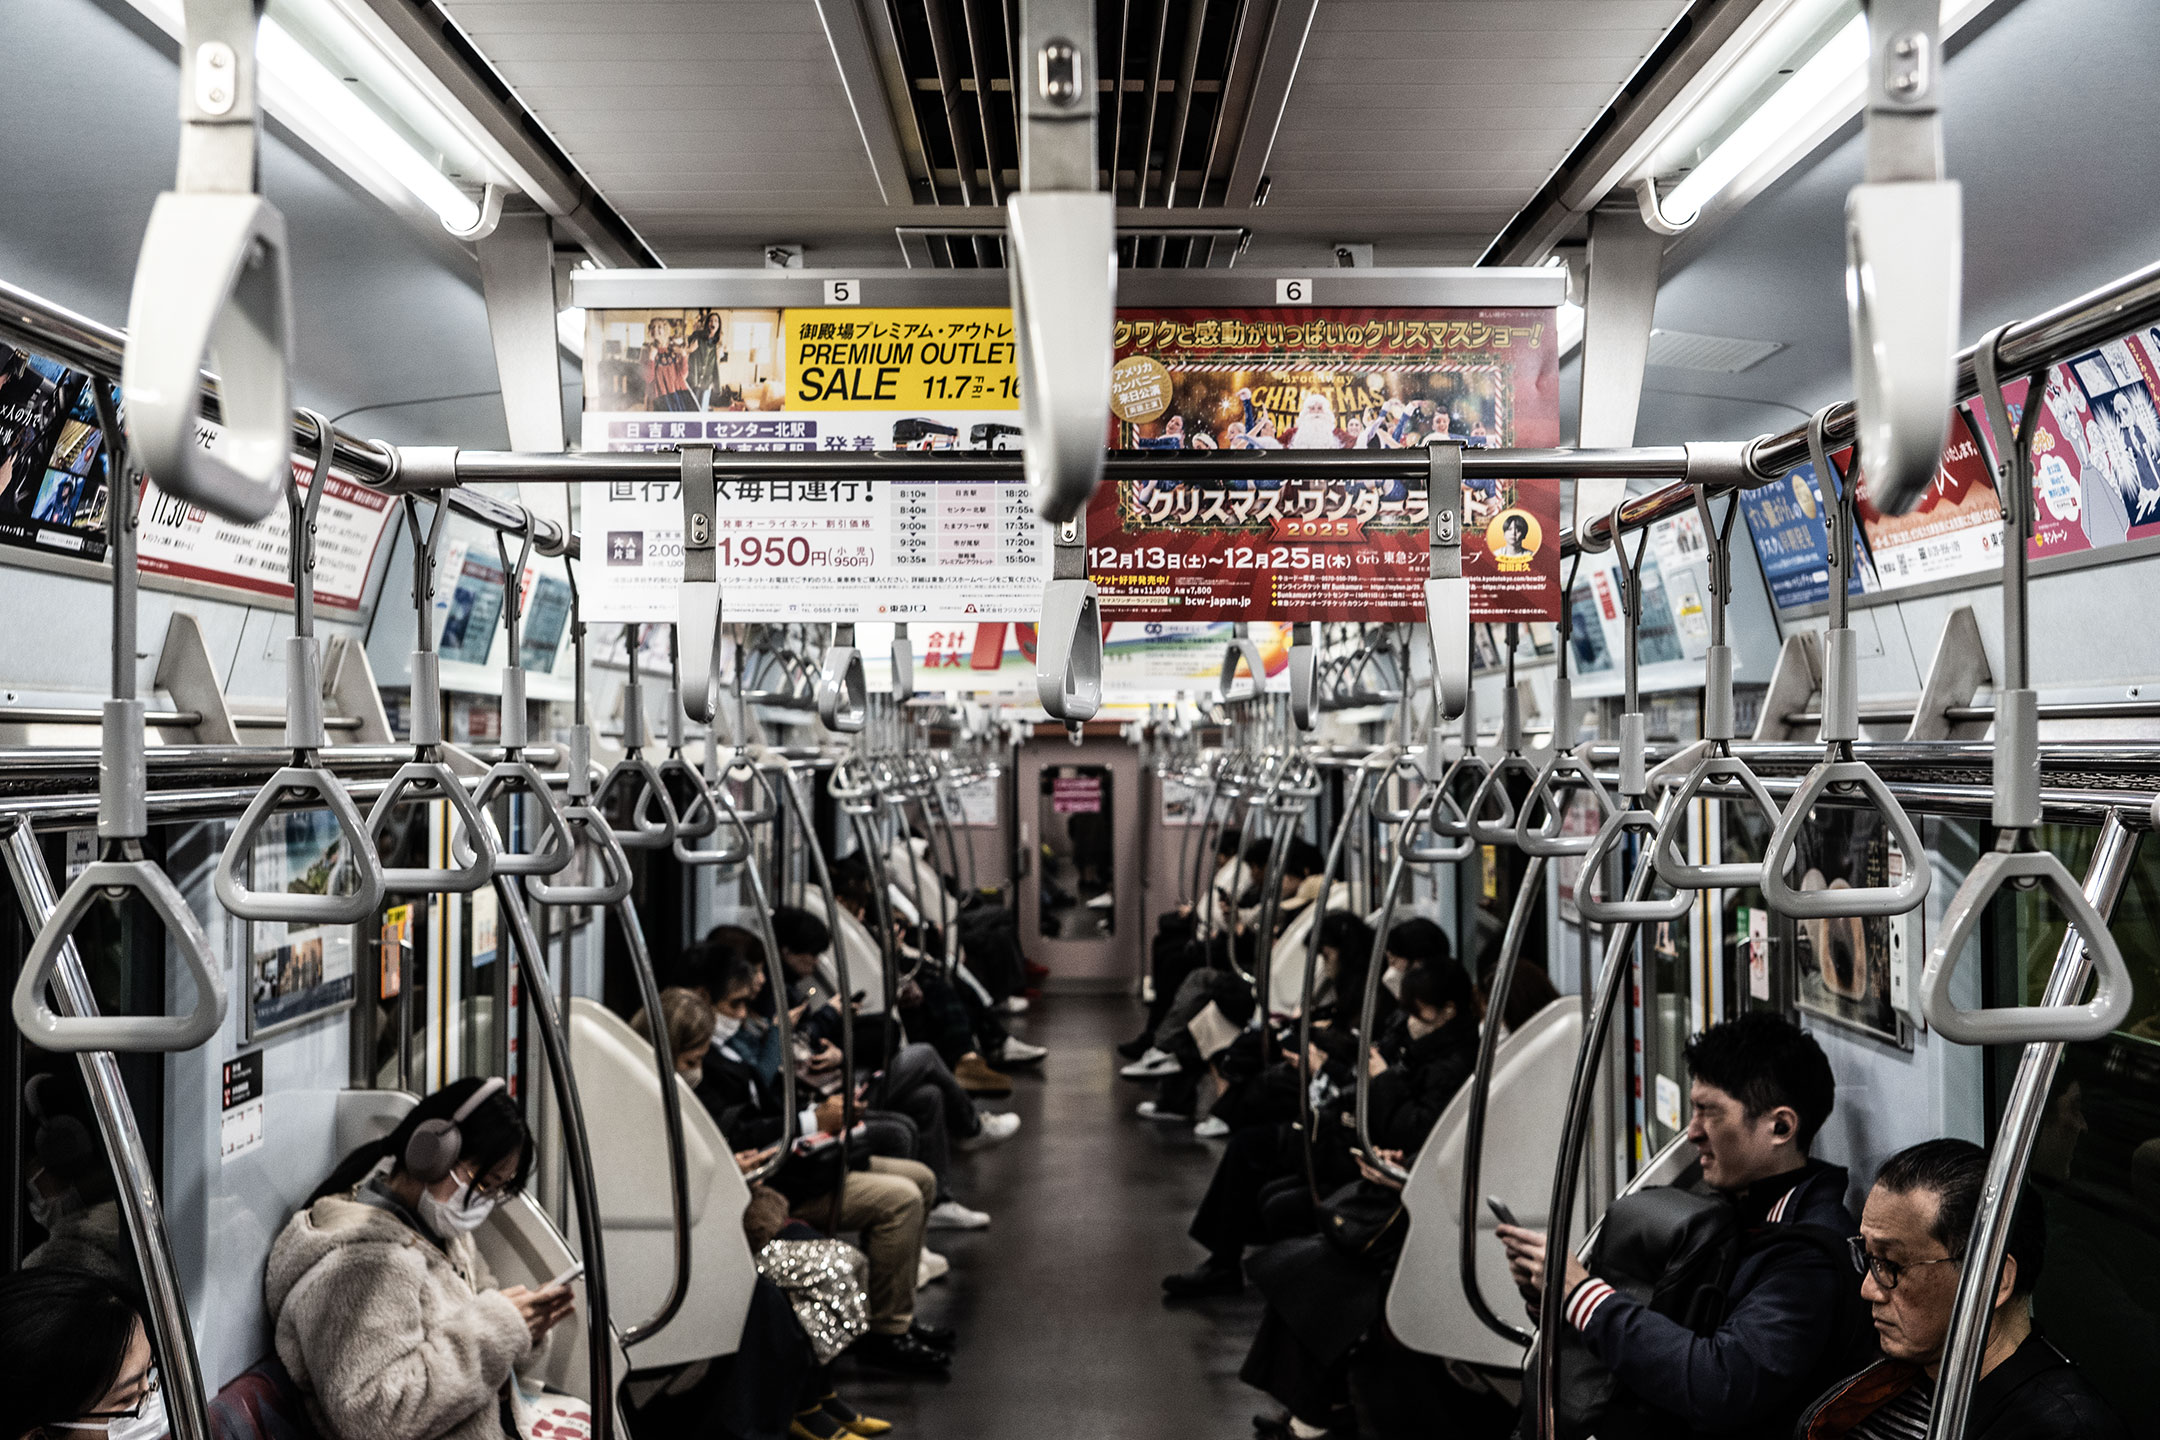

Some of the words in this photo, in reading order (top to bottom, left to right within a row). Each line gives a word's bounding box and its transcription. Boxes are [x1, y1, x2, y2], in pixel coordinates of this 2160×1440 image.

[834, 282, 848, 300] 5
[1287, 282, 1301, 300] 6
[799, 322, 1016, 340] 御殿場プレミアム・アウトレ
[799, 343, 914, 365] PREMIUM
[1115, 362, 1153, 381] アメリカ
[799, 367, 900, 401] SALE
[923, 376, 970, 399] 11.7
[971, 376, 985, 398] FRI
[1113, 375, 1162, 394] カンパニー
[1282, 374, 1354, 386] Broadway
[627, 423, 686, 438] 日吉駅
[714, 423, 806, 438] センター北駅
[1148, 488, 1490, 525] クリスマス・ワンダーラド
[723, 519, 818, 529] 発車オーライネット
[826, 519, 871, 529] 割引価格
[1287, 523, 1350, 537] 2025
[614, 536, 637, 548] 大人
[954, 539, 980, 547] 市が尾駅
[614, 548, 636, 560] 片道
[718, 536, 827, 567] 1,950円
[837, 546, 866, 556] 小児
[1356, 554, 1379, 564] Orb
[890, 604, 927, 613] 東急バス
[1185, 596, 1251, 608] bcw-japan.jp
[928, 629, 966, 649] 合計
